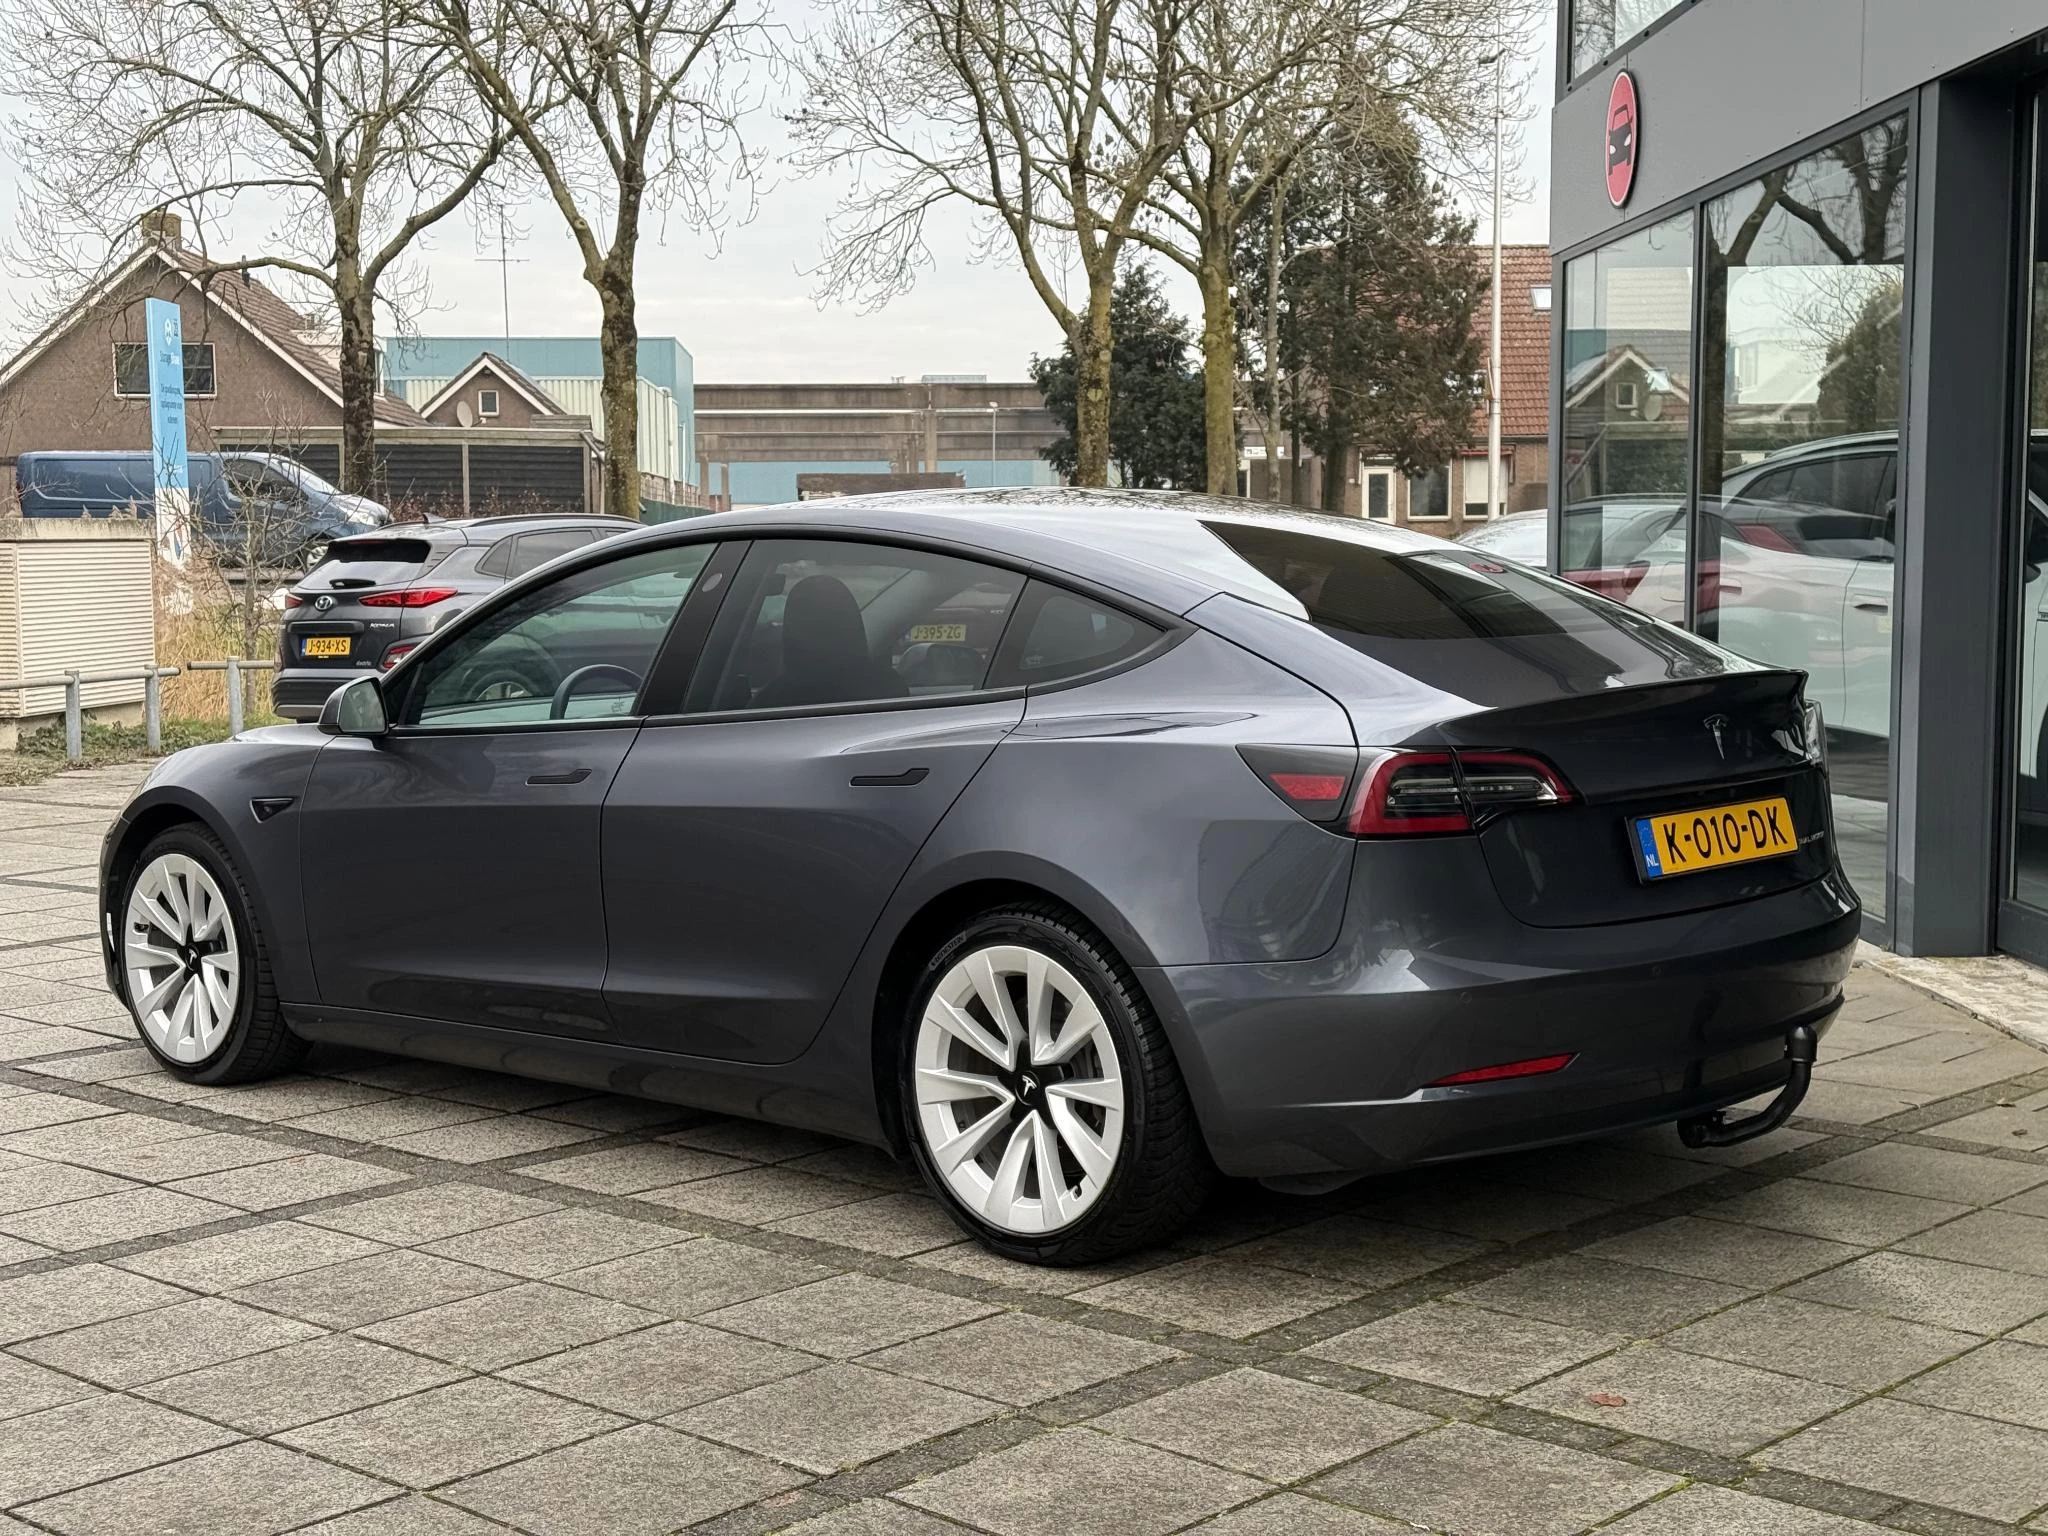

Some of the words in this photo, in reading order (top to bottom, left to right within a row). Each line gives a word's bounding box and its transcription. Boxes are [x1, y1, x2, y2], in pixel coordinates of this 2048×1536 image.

[914, 626, 961, 640] J-395-ZG
[308, 640, 347, 653] J-934-XS
[1663, 806, 1788, 864] K-010-DK
[1645, 853, 1659, 867] NL
